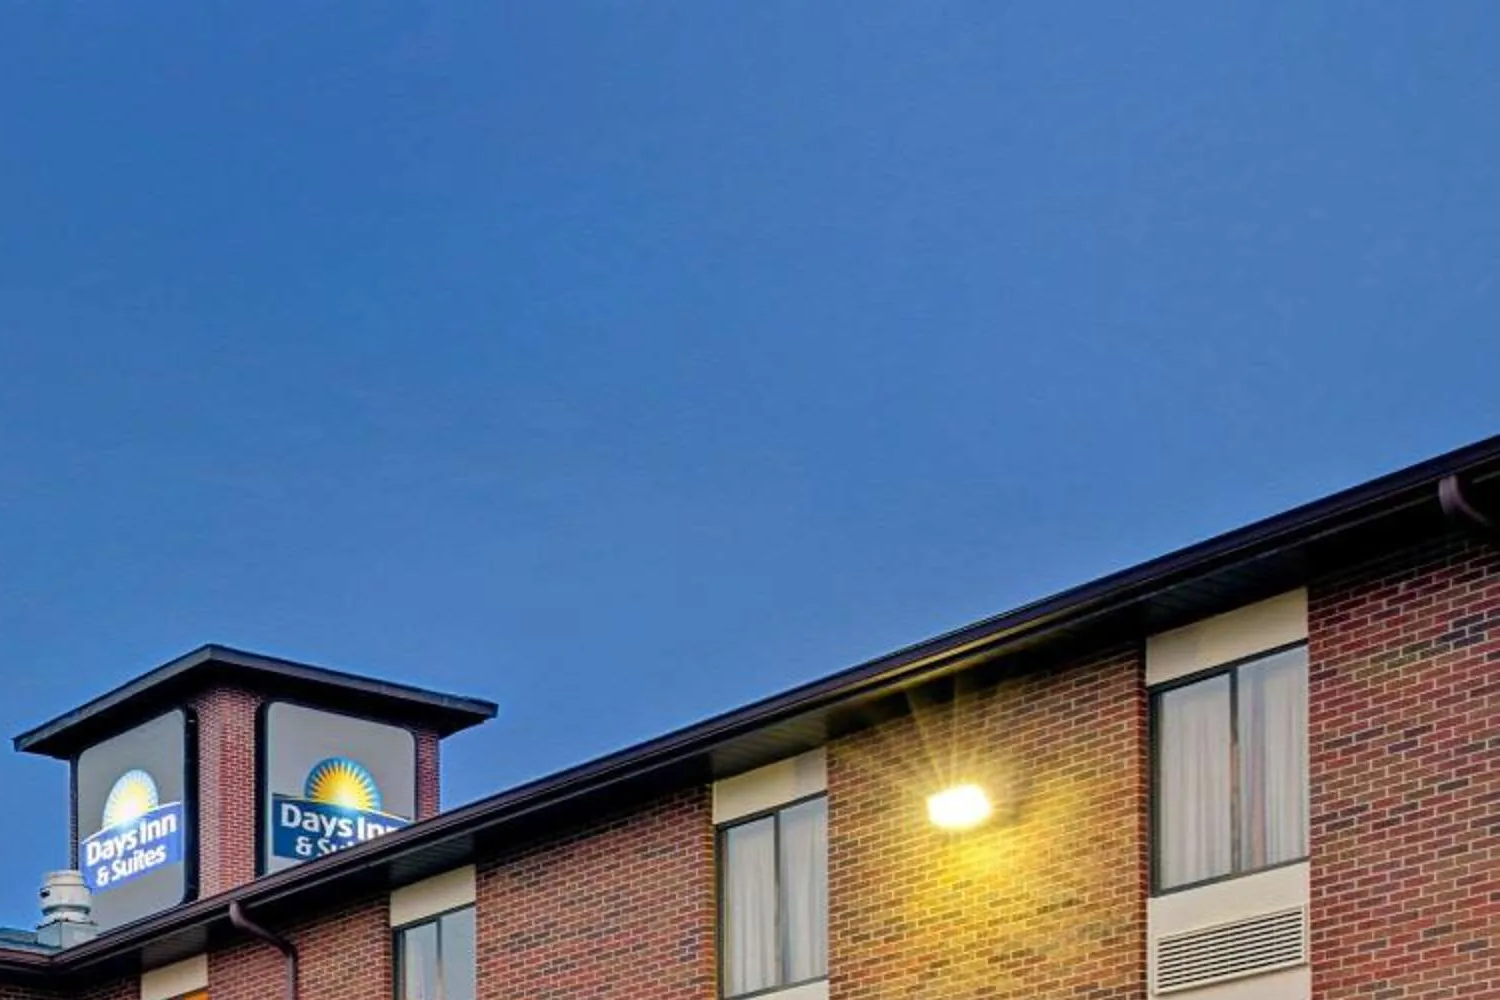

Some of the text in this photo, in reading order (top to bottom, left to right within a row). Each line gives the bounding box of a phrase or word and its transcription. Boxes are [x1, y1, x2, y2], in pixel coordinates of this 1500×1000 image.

[281, 802, 353, 838] Days
[86, 813, 177, 867] Days Inn
[296, 835, 313, 857] &
[96, 844, 166, 887] & Suites
